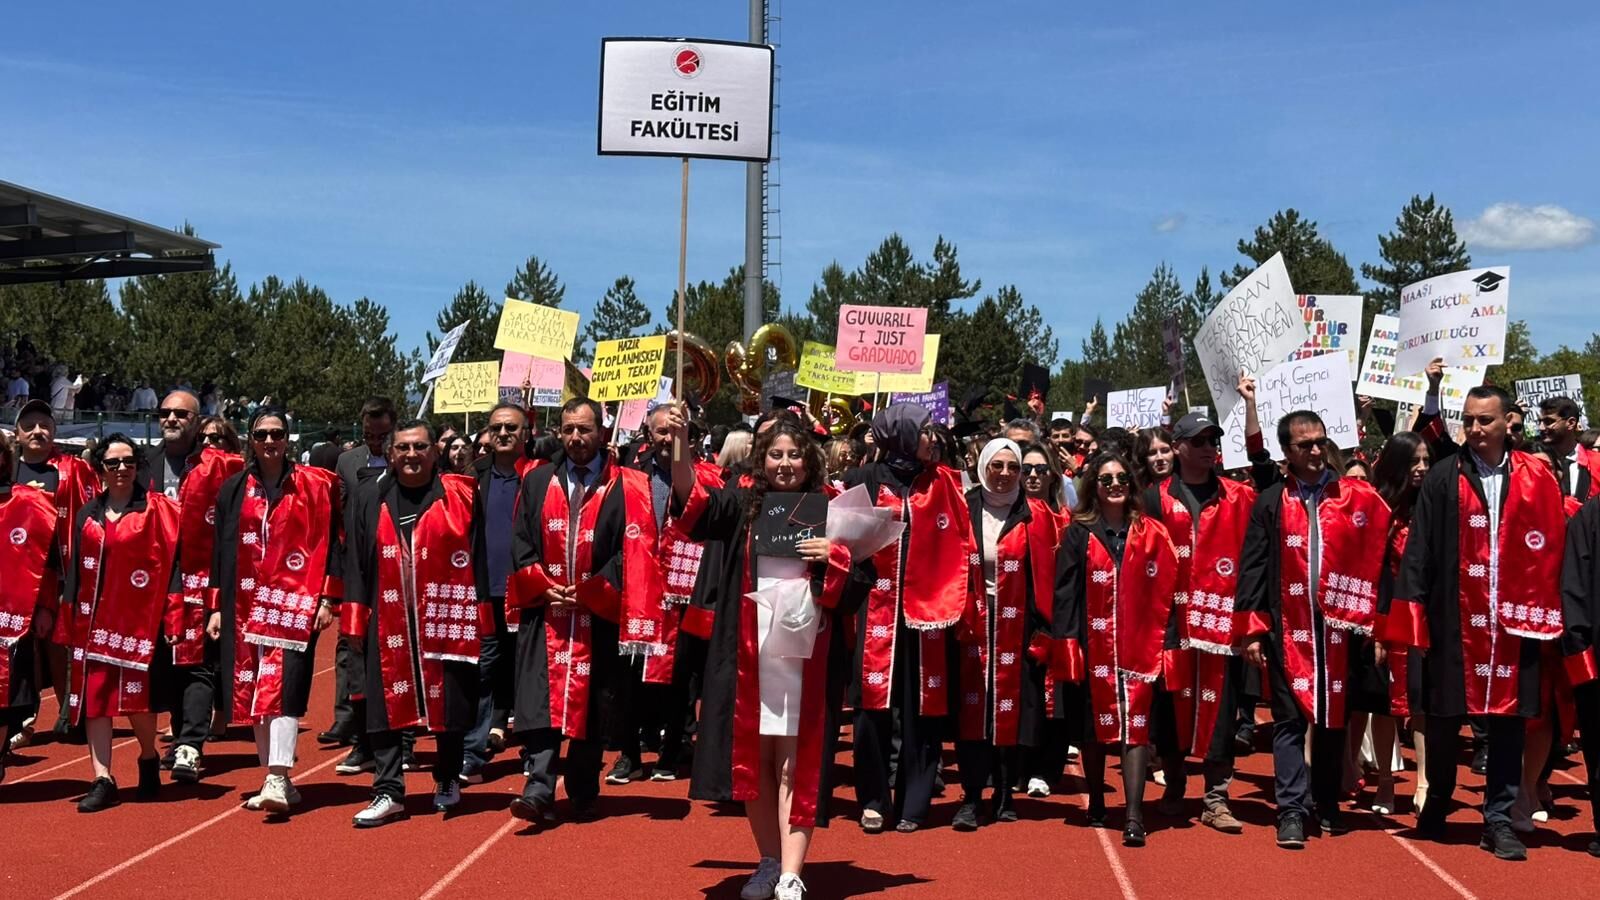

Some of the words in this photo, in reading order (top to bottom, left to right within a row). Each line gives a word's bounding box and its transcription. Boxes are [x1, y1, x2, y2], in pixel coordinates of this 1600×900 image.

[651, 90, 721, 113] EĞİTİM
[631, 118, 738, 141] FAKÜLTESİ
[846, 310, 914, 328] GUUURRLL
[1471, 305, 1505, 318] AMA
[858, 331, 864, 343] I
[874, 330, 906, 345] JUST
[849, 347, 917, 366] GRADUADO
[1462, 344, 1499, 358] XXL
[1292, 366, 1329, 385] Genci
